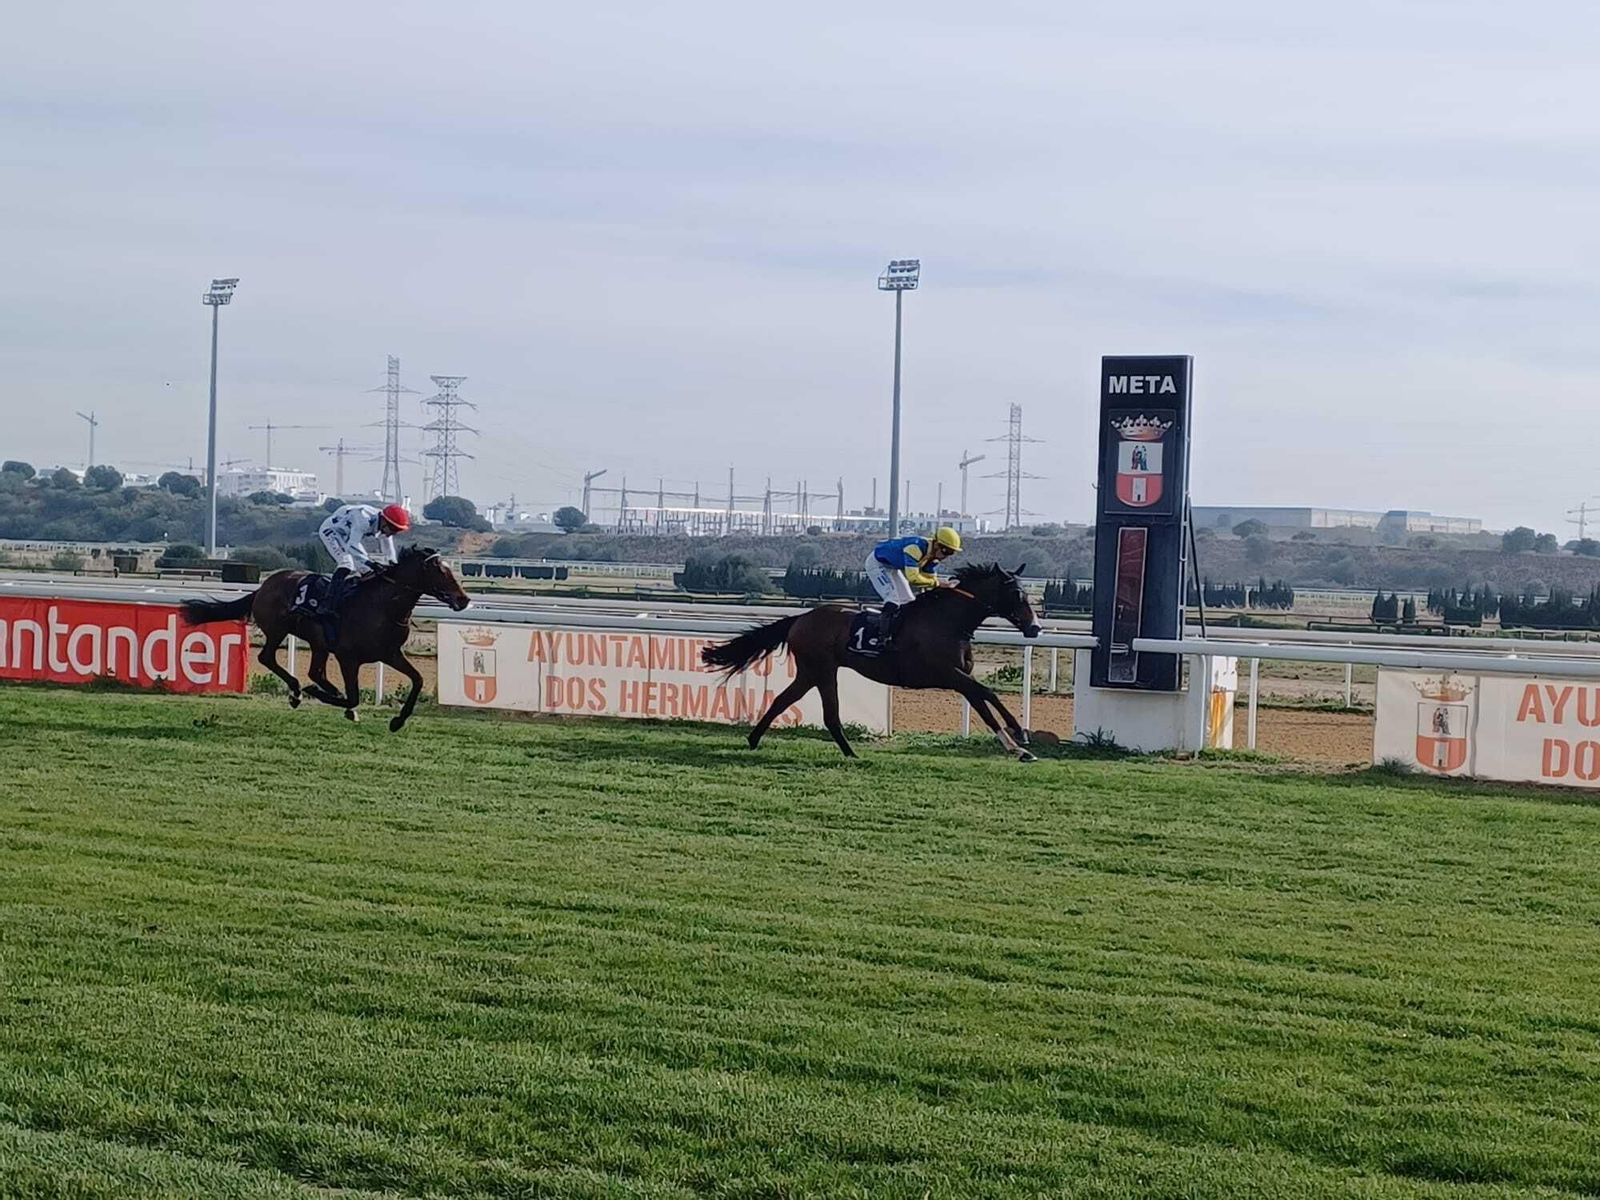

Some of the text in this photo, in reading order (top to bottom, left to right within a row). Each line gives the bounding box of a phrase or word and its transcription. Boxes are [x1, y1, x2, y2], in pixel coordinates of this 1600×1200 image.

[1109, 376, 1176, 393] META
[527, 631, 773, 677] AYUNTAMIEO
[855, 627, 864, 649] 1
[546, 675, 606, 711] DOS
[1516, 684, 1600, 727] AYU
[1542, 738, 1600, 780] DO
